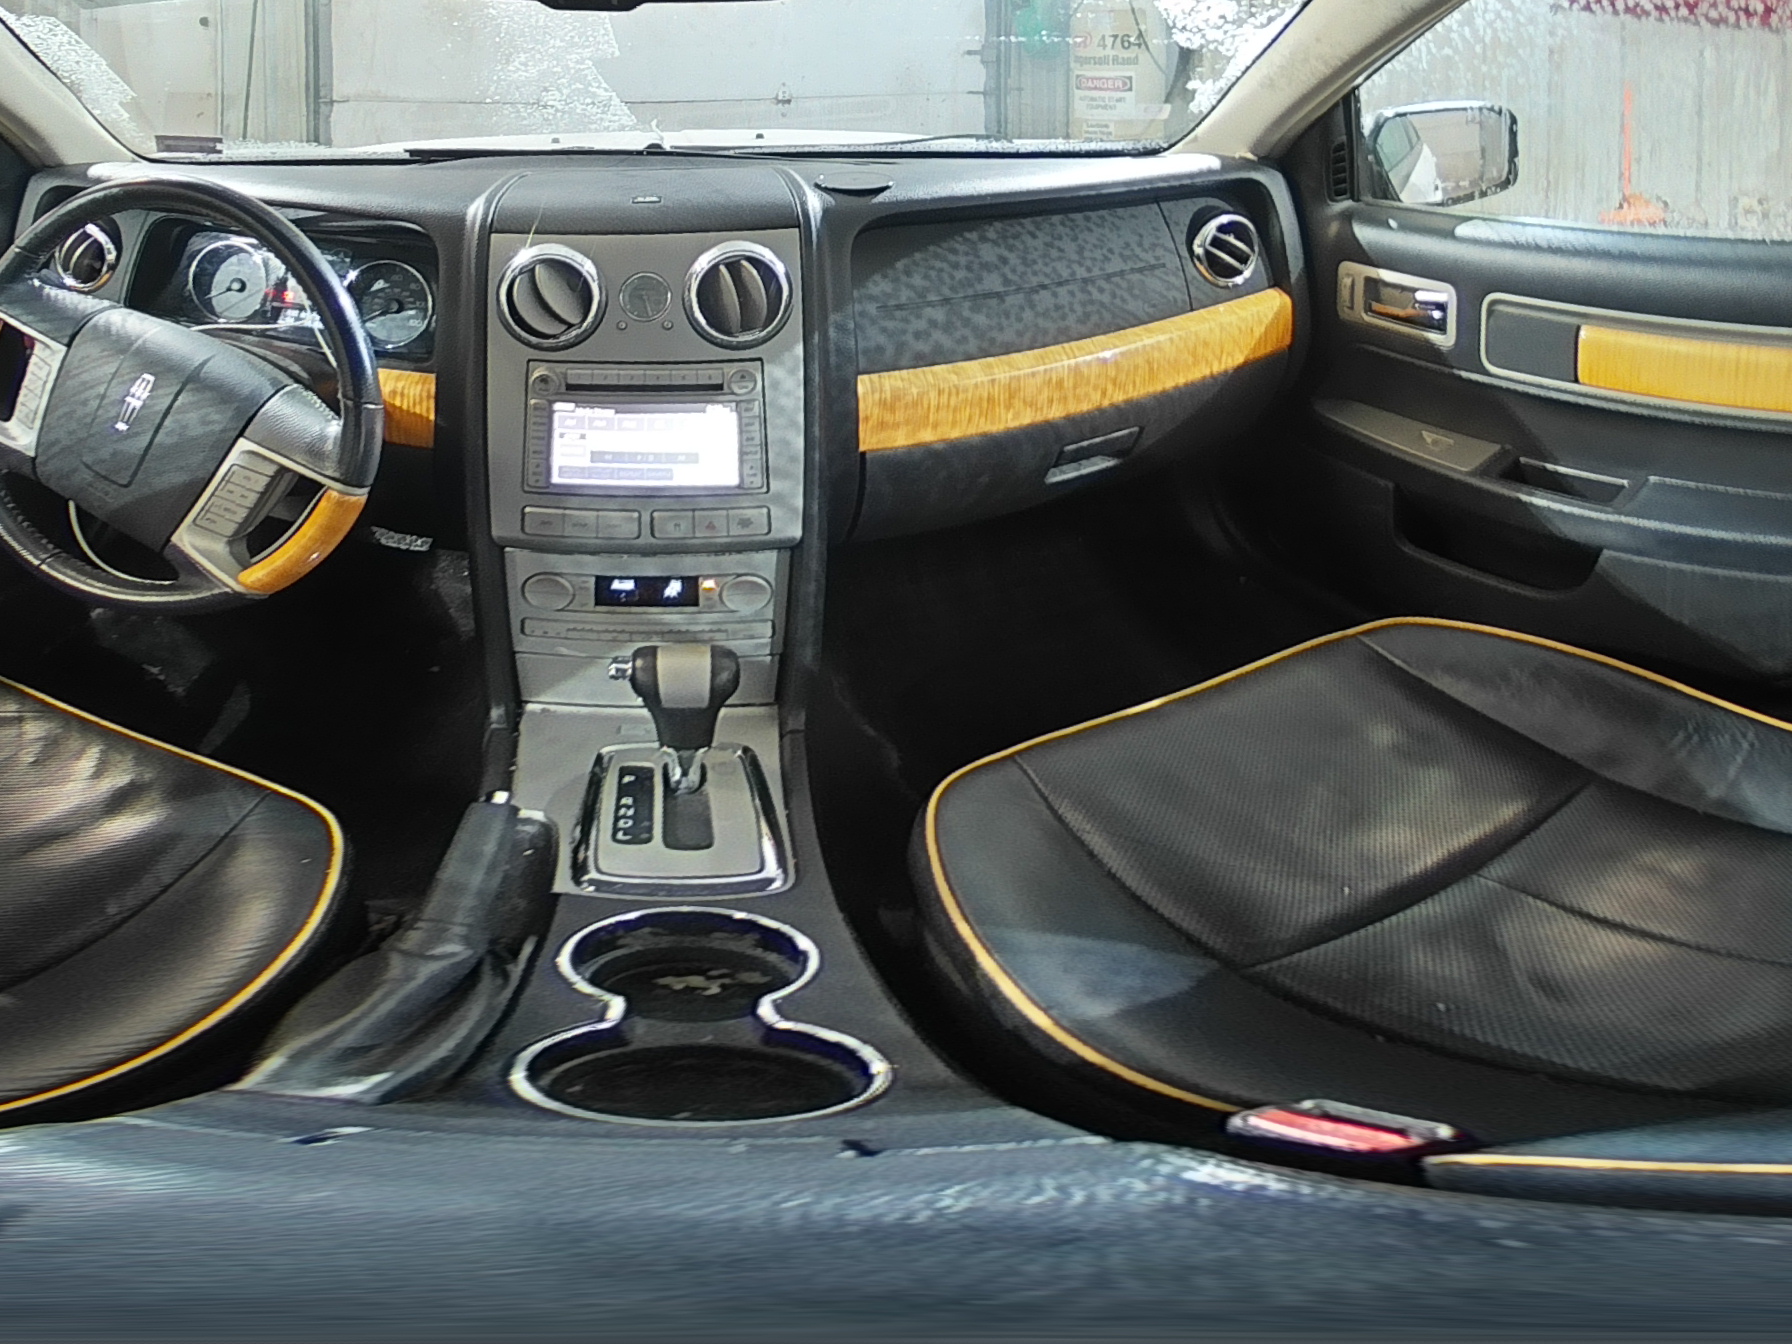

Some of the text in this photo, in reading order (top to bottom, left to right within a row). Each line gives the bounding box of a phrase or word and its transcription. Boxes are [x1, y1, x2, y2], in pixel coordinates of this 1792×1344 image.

[1097, 34, 1143, 50] 4764
[1112, 54, 1139, 66] Rand
[1080, 79, 1123, 89] DANGER
[617, 807, 635, 817] N
[616, 818, 634, 828] D
[615, 829, 632, 840] L
